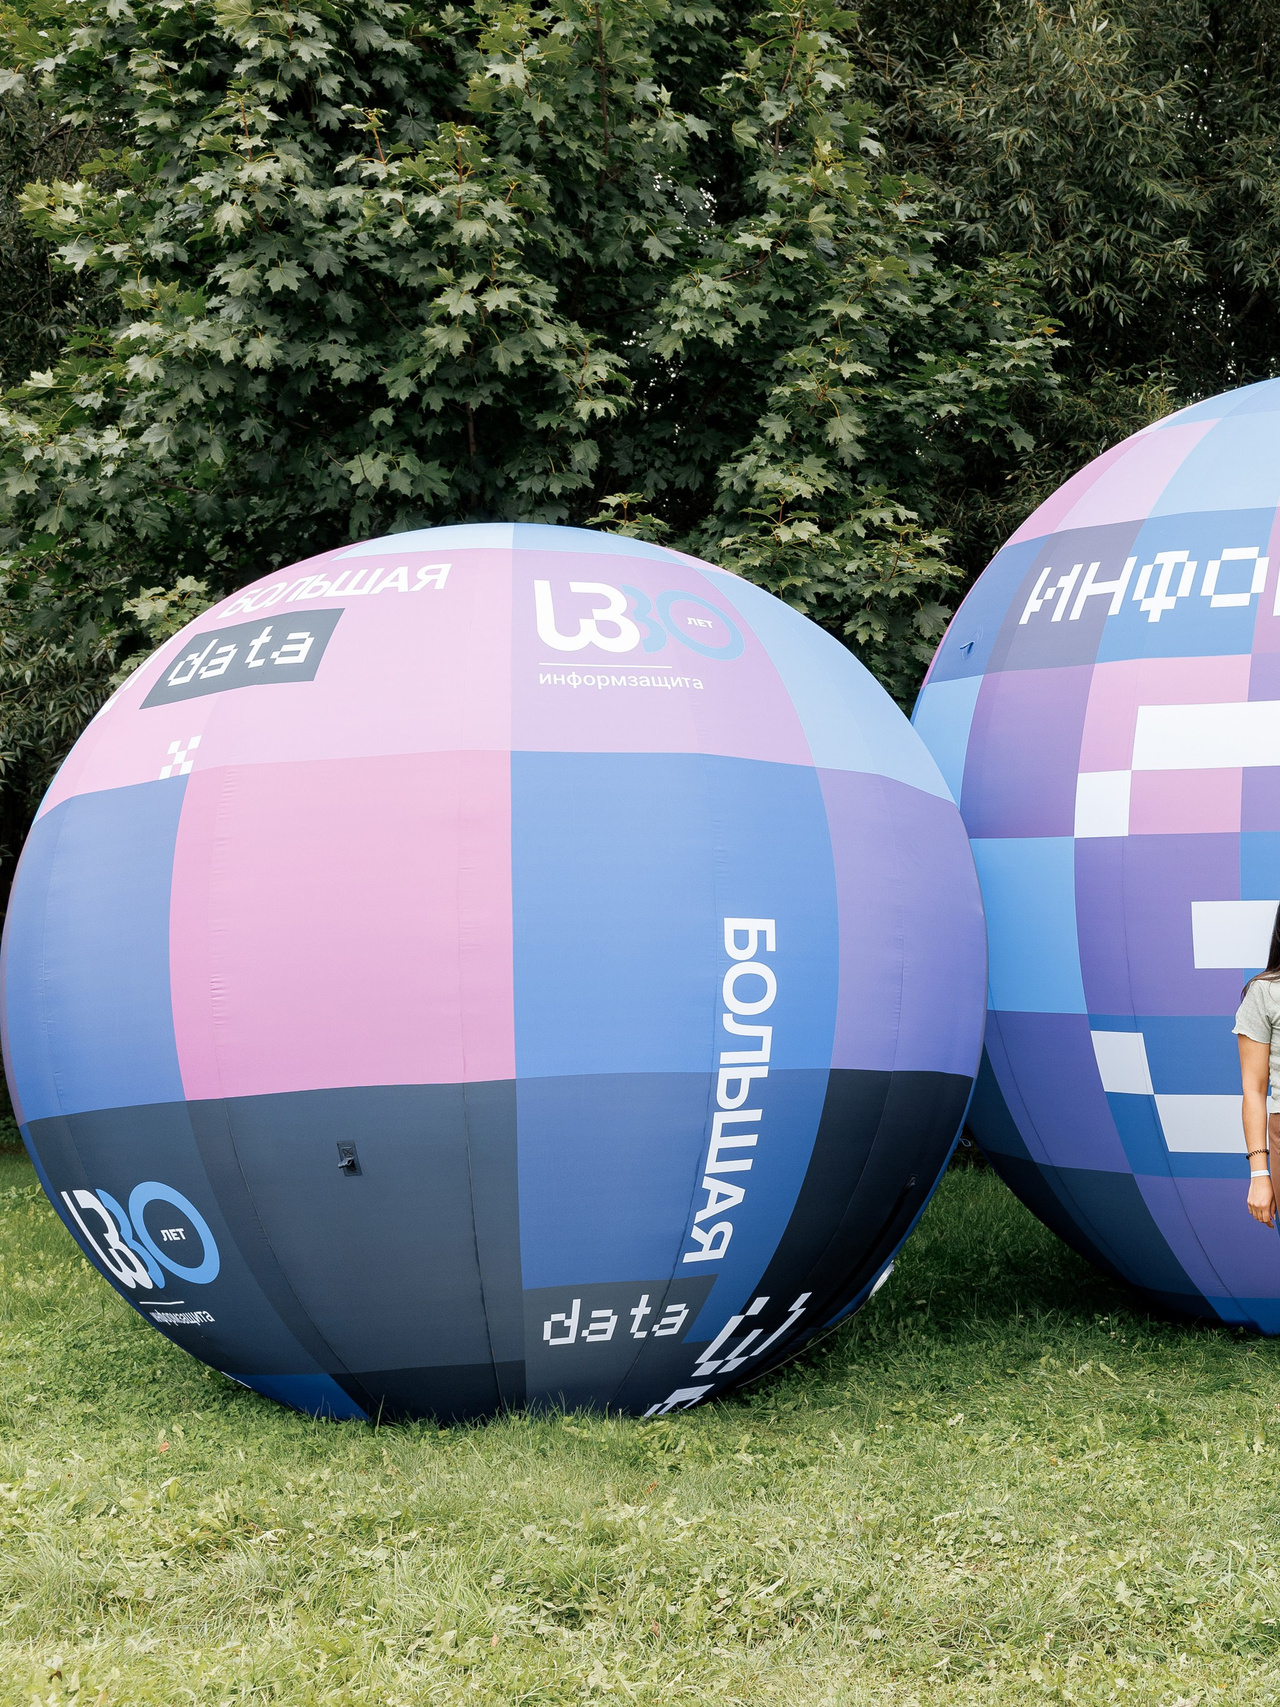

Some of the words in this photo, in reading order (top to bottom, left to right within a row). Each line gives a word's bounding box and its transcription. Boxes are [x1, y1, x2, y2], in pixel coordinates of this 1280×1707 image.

[216, 563, 453, 620] БОЛЬШАЯ
[686, 616, 714, 629] ЛЕТ
[167, 625, 315, 687] data
[539, 671, 705, 690] информзащита
[682, 917, 777, 1264] БОЛЬШАЯ
[160, 1227, 187, 1242] ЛЕТ
[543, 1294, 690, 1346] data
